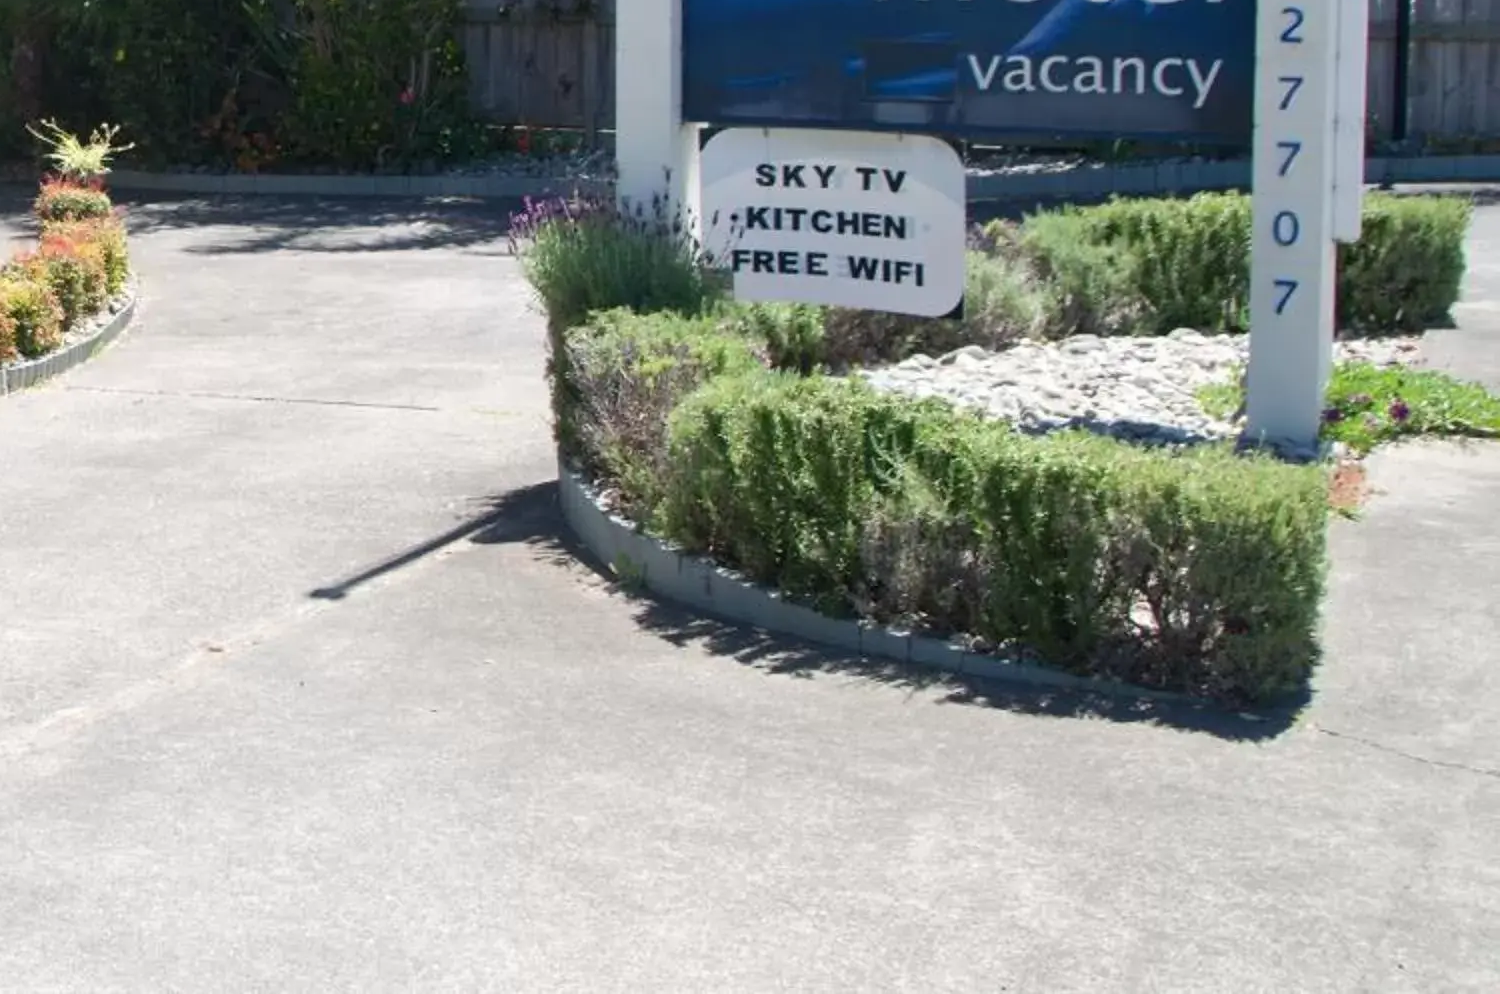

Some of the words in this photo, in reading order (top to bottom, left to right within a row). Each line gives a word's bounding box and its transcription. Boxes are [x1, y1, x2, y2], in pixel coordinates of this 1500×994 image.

[967, 54, 1224, 109] vacancy
[755, 163, 836, 189] SKY
[856, 167, 907, 193] TV
[745, 206, 906, 239] KITCHEN
[731, 249, 829, 277] FREE
[847, 256, 925, 287] WIFI
